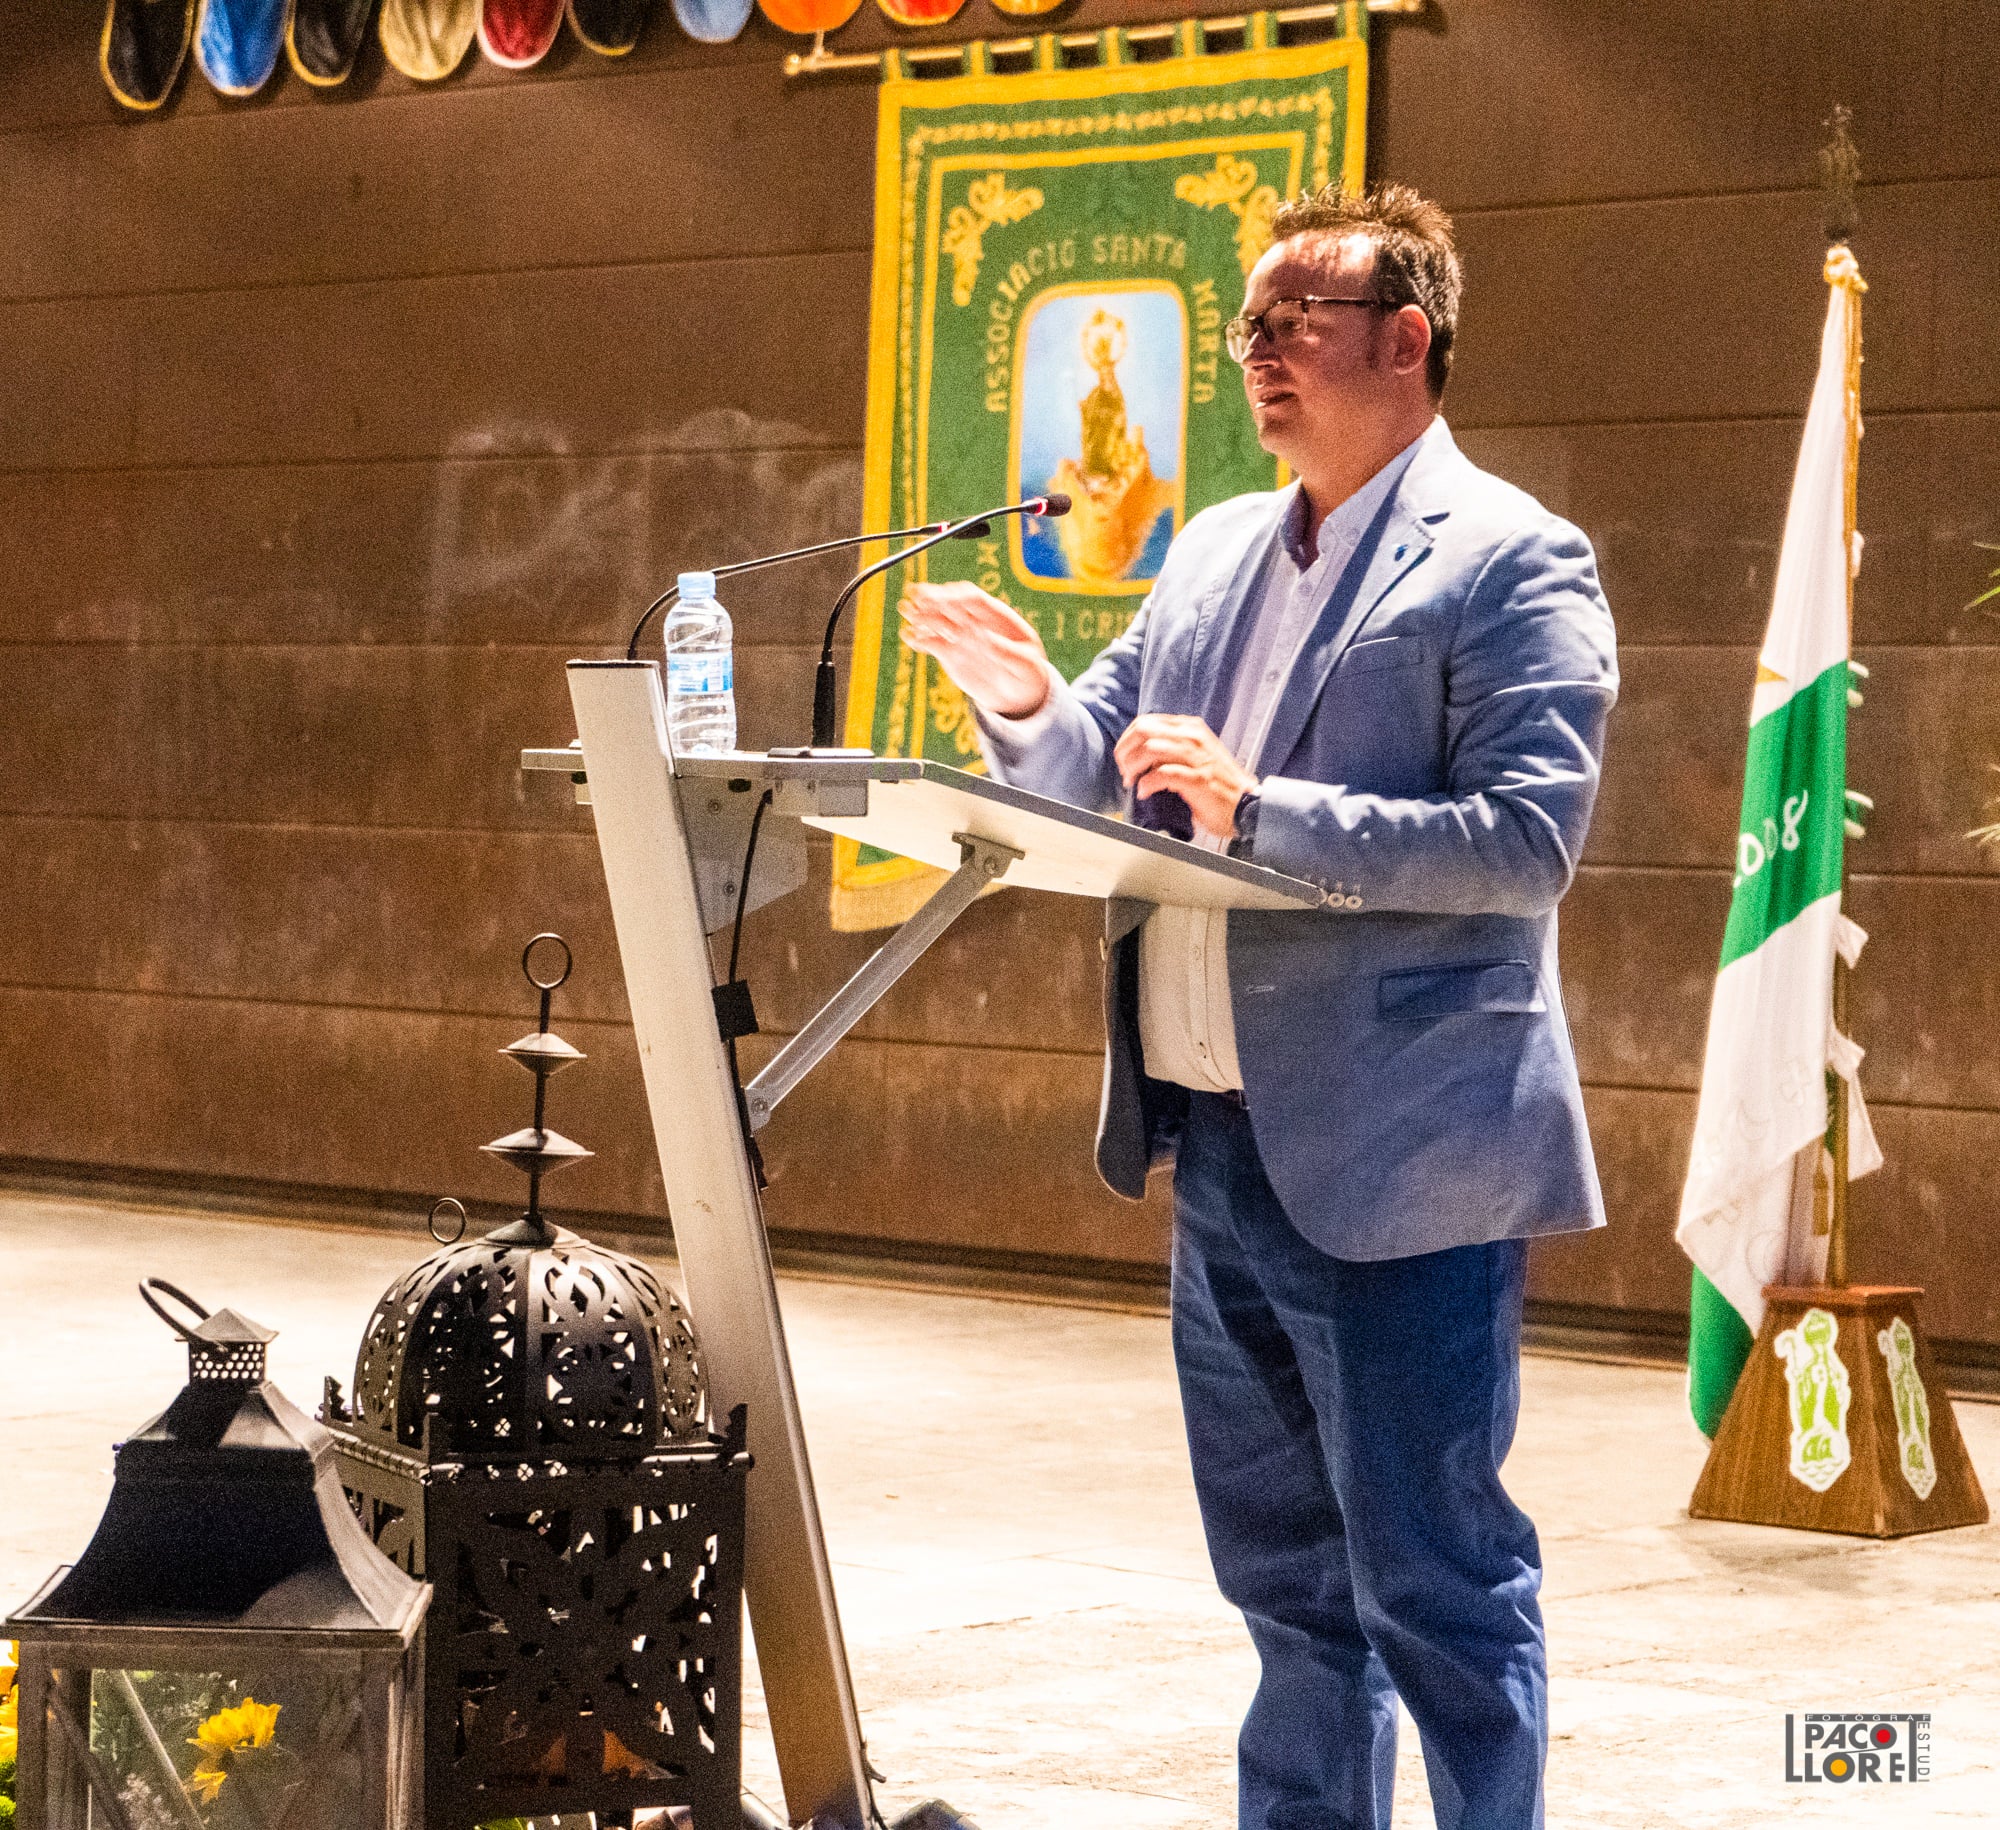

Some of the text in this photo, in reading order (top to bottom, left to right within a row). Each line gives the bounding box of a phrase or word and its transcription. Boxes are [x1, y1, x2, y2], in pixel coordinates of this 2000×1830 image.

[1092, 233, 1186, 269] SANTA
[1191, 279, 1222, 404] MARTA
[1056, 611, 1066, 641] I
[1733, 789, 1809, 888] 008
